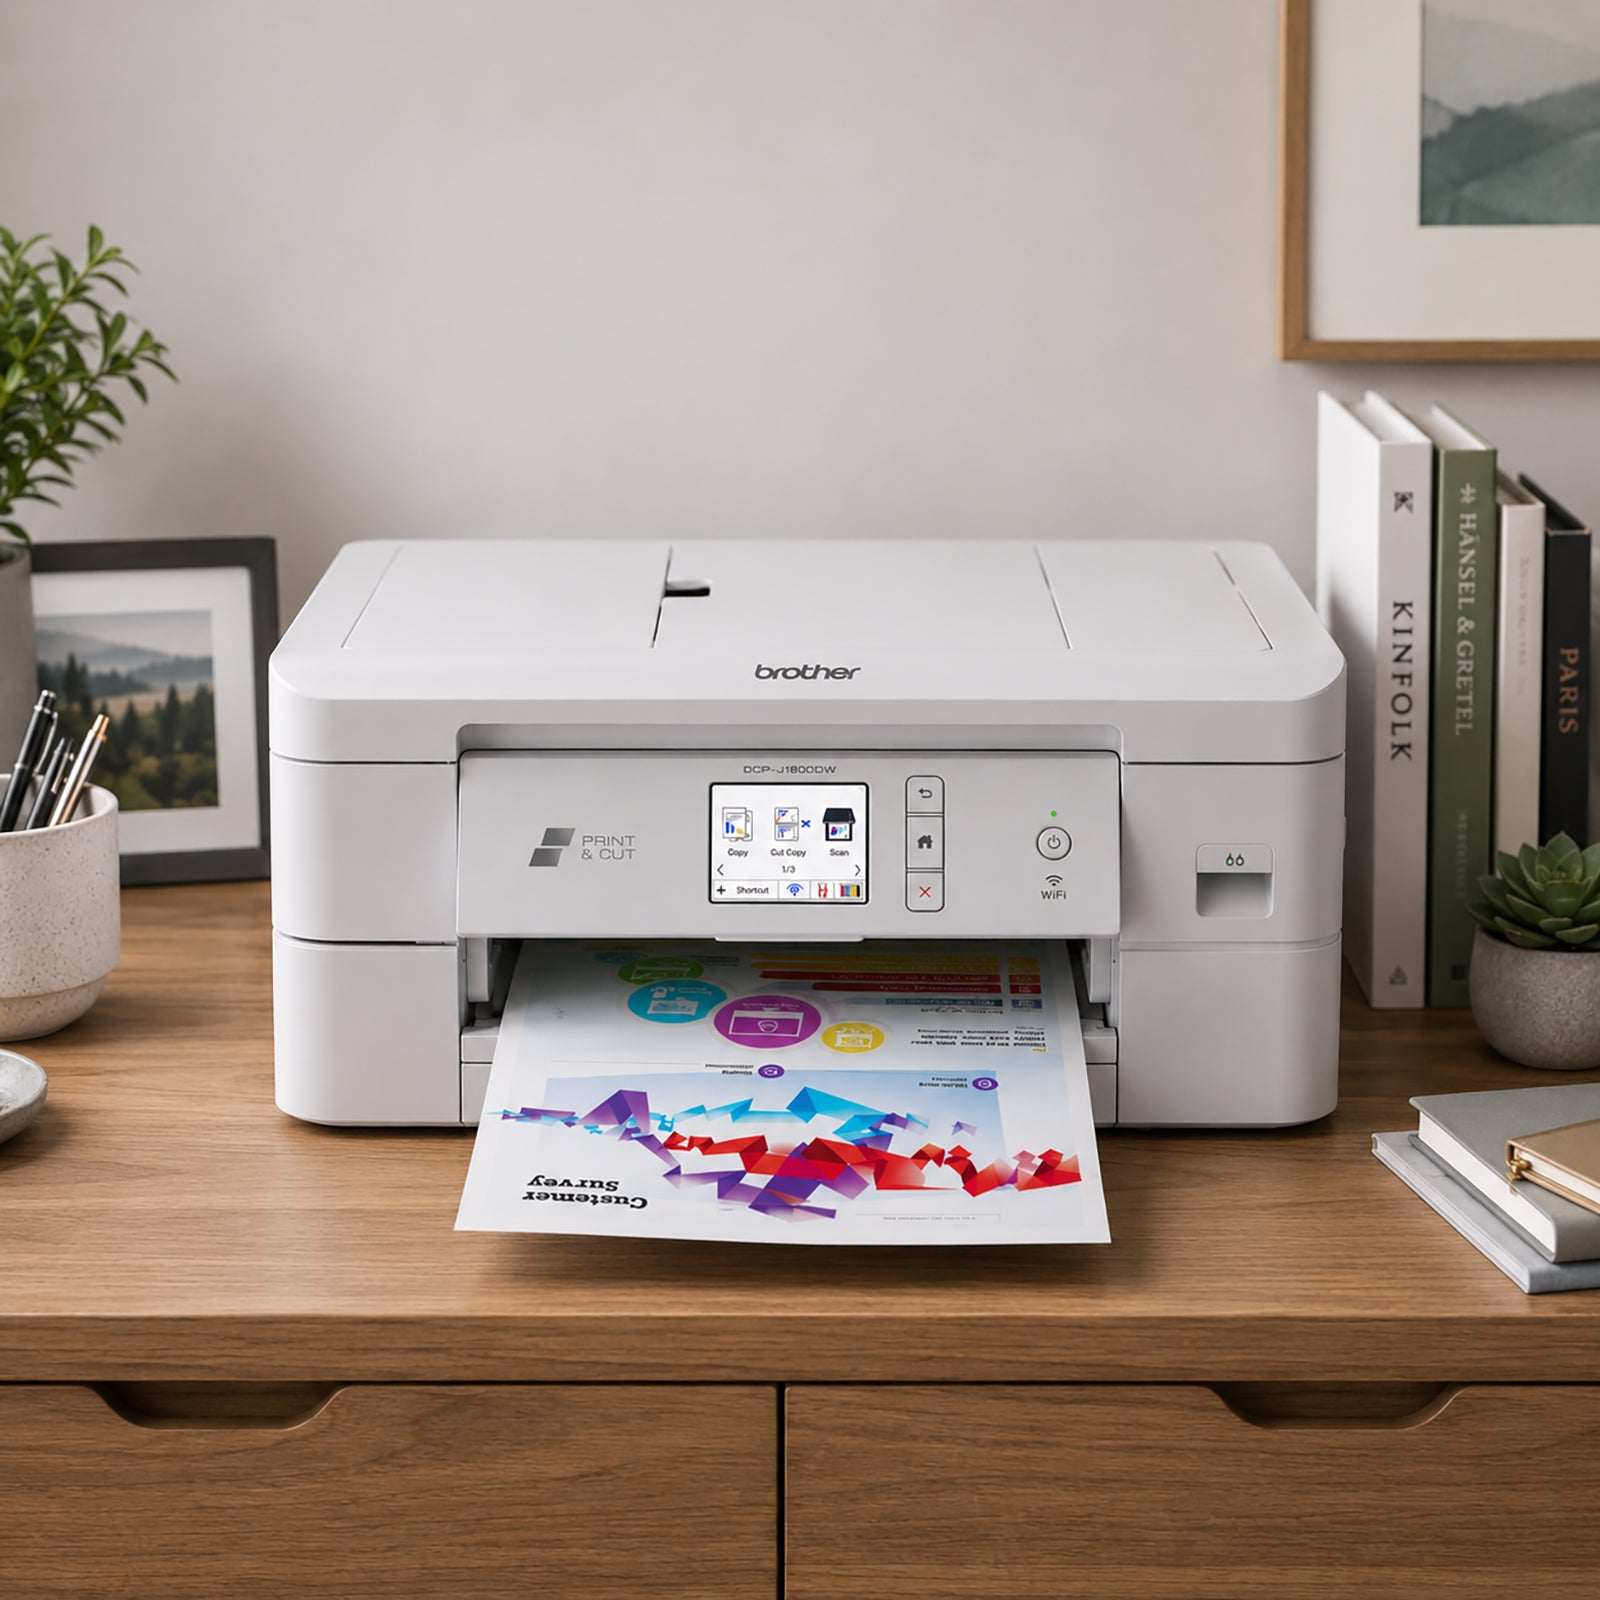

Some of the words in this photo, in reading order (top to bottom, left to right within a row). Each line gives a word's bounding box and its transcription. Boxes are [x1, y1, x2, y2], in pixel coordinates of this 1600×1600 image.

[1457, 616, 1475, 635] &
[755, 664, 861, 680] brother
[1391, 601, 1413, 760] KINFOLK
[1455, 640, 1475, 737] GRETEL
[1558, 647, 1580, 734] PARIS
[743, 765, 837, 775] DCP-J1800DW
[582, 835, 636, 847] PRINT
[581, 848, 593, 860] &
[599, 848, 636, 860] CUT
[727, 848, 748, 857] Copy
[770, 848, 785, 856] Cut
[786, 848, 807, 857] Copy
[829, 848, 849, 856] Scan
[781, 865, 796, 873] 1/3
[736, 886, 769, 894] Shortcut
[1041, 890, 1067, 900] WiFi
[527, 1174, 619, 1192] Survey
